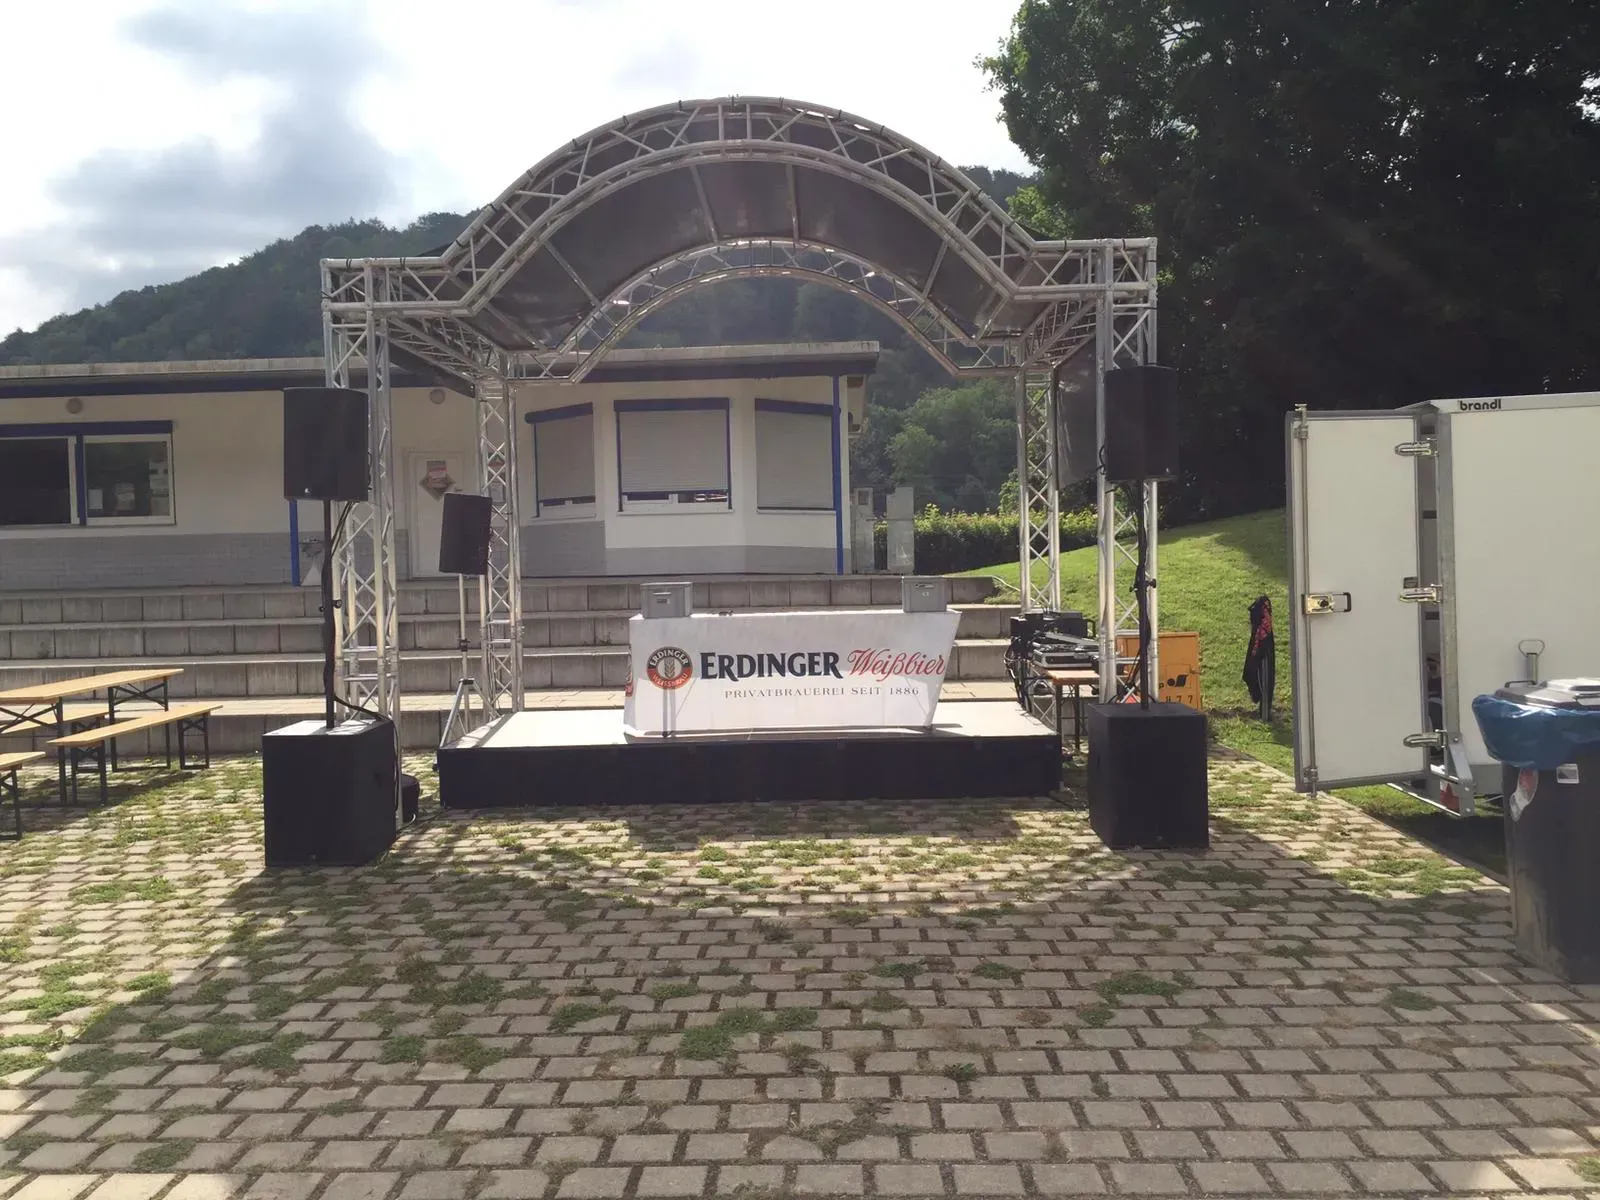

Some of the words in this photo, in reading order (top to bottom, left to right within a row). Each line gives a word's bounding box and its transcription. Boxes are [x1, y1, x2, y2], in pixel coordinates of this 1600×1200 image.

[1460, 399, 1502, 411] brandl
[649, 649, 689, 666] ERDINGER
[700, 652, 844, 682] ERDINGER
[847, 648, 945, 682] Weißbier
[724, 687, 845, 699] PRIVATBRAUEREI
[851, 686, 881, 696] SEIT
[889, 686, 919, 696] 1886
